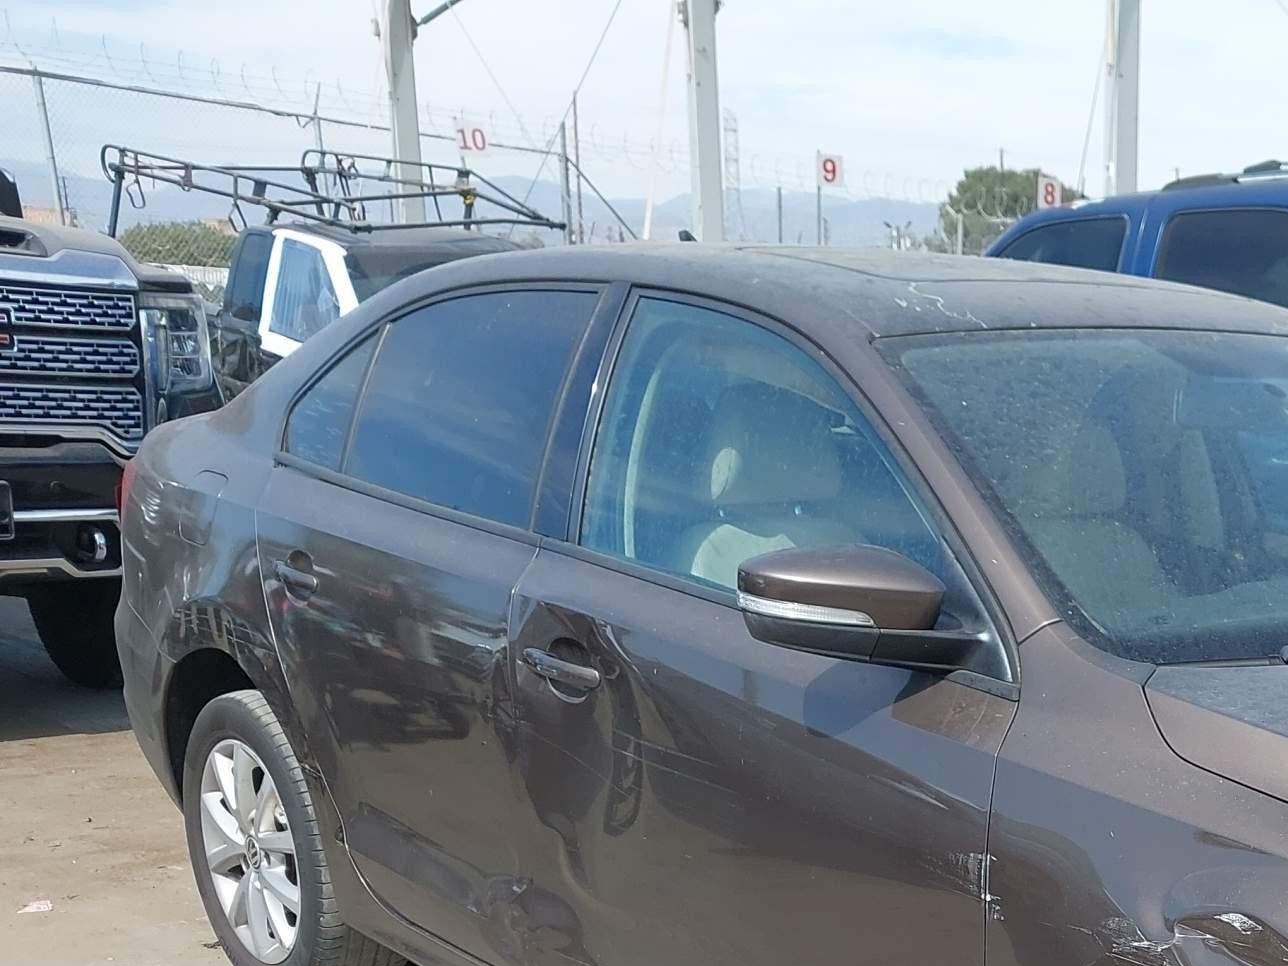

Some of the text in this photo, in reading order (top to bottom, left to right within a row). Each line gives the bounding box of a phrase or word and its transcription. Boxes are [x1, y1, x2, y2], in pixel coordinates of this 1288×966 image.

[456, 128, 486, 151] 10
[823, 158, 836, 182] 9
[1044, 181, 1055, 205] 8
